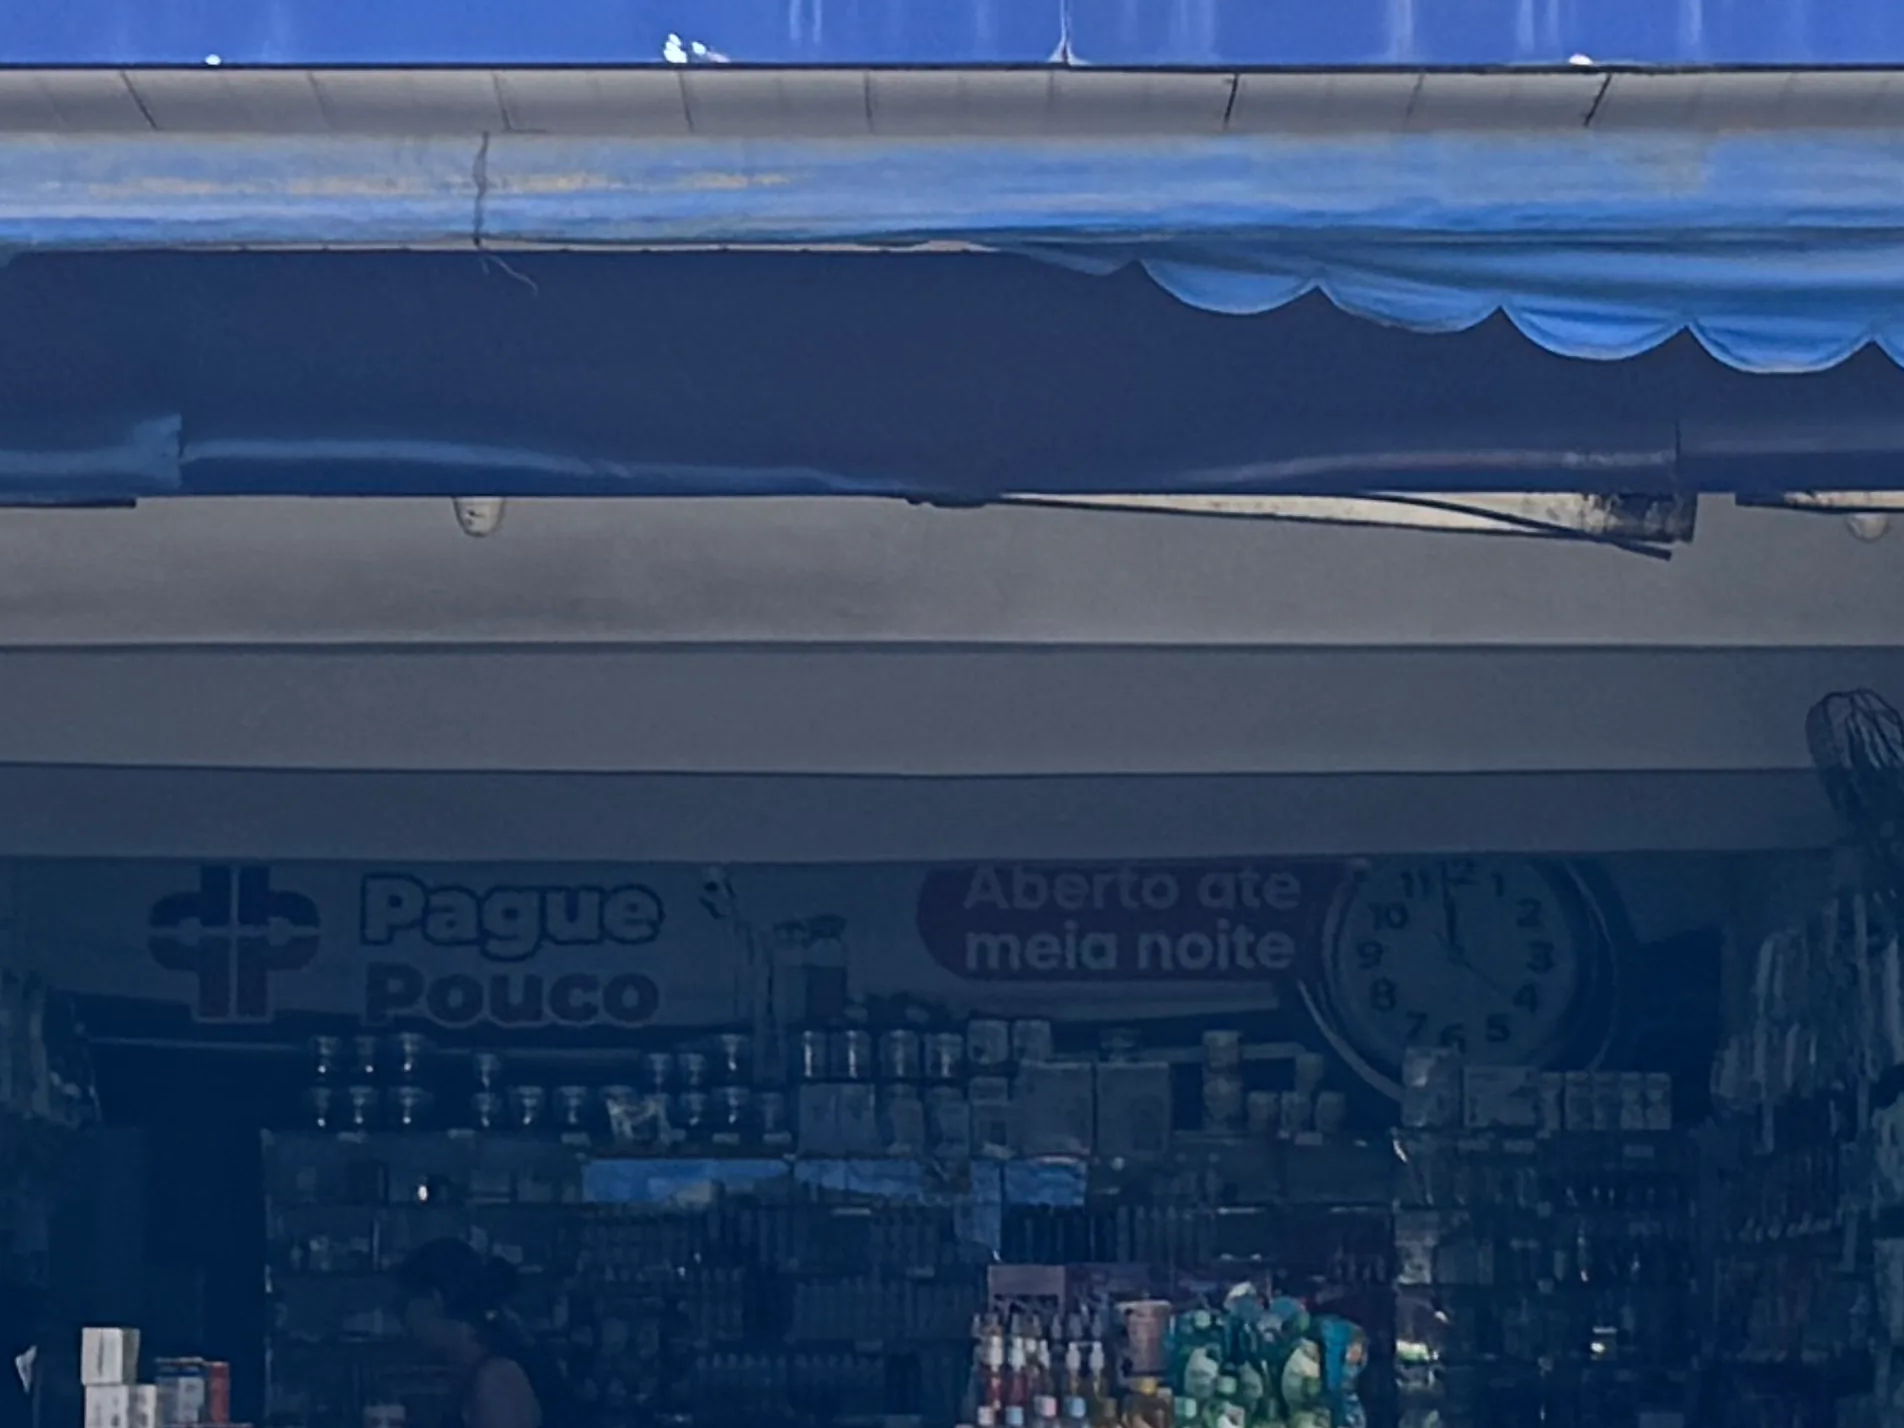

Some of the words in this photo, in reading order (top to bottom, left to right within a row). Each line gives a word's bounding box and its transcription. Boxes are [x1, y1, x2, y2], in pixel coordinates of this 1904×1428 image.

[962, 862, 1178, 910] Aberto
[360, 871, 666, 962] Pague
[1367, 900, 1410, 932] 10
[1516, 898, 1542, 928] 2
[964, 919, 1118, 971] meia
[1136, 917, 1296, 971] noite
[1357, 940, 1384, 970] 9
[1526, 941, 1554, 974] 3
[366, 961, 661, 1028] Pouco
[1370, 976, 1397, 1013] 8
[1512, 982, 1539, 1013] 4
[1405, 1010, 1428, 1039] 7
[1485, 1013, 1511, 1043] 5
